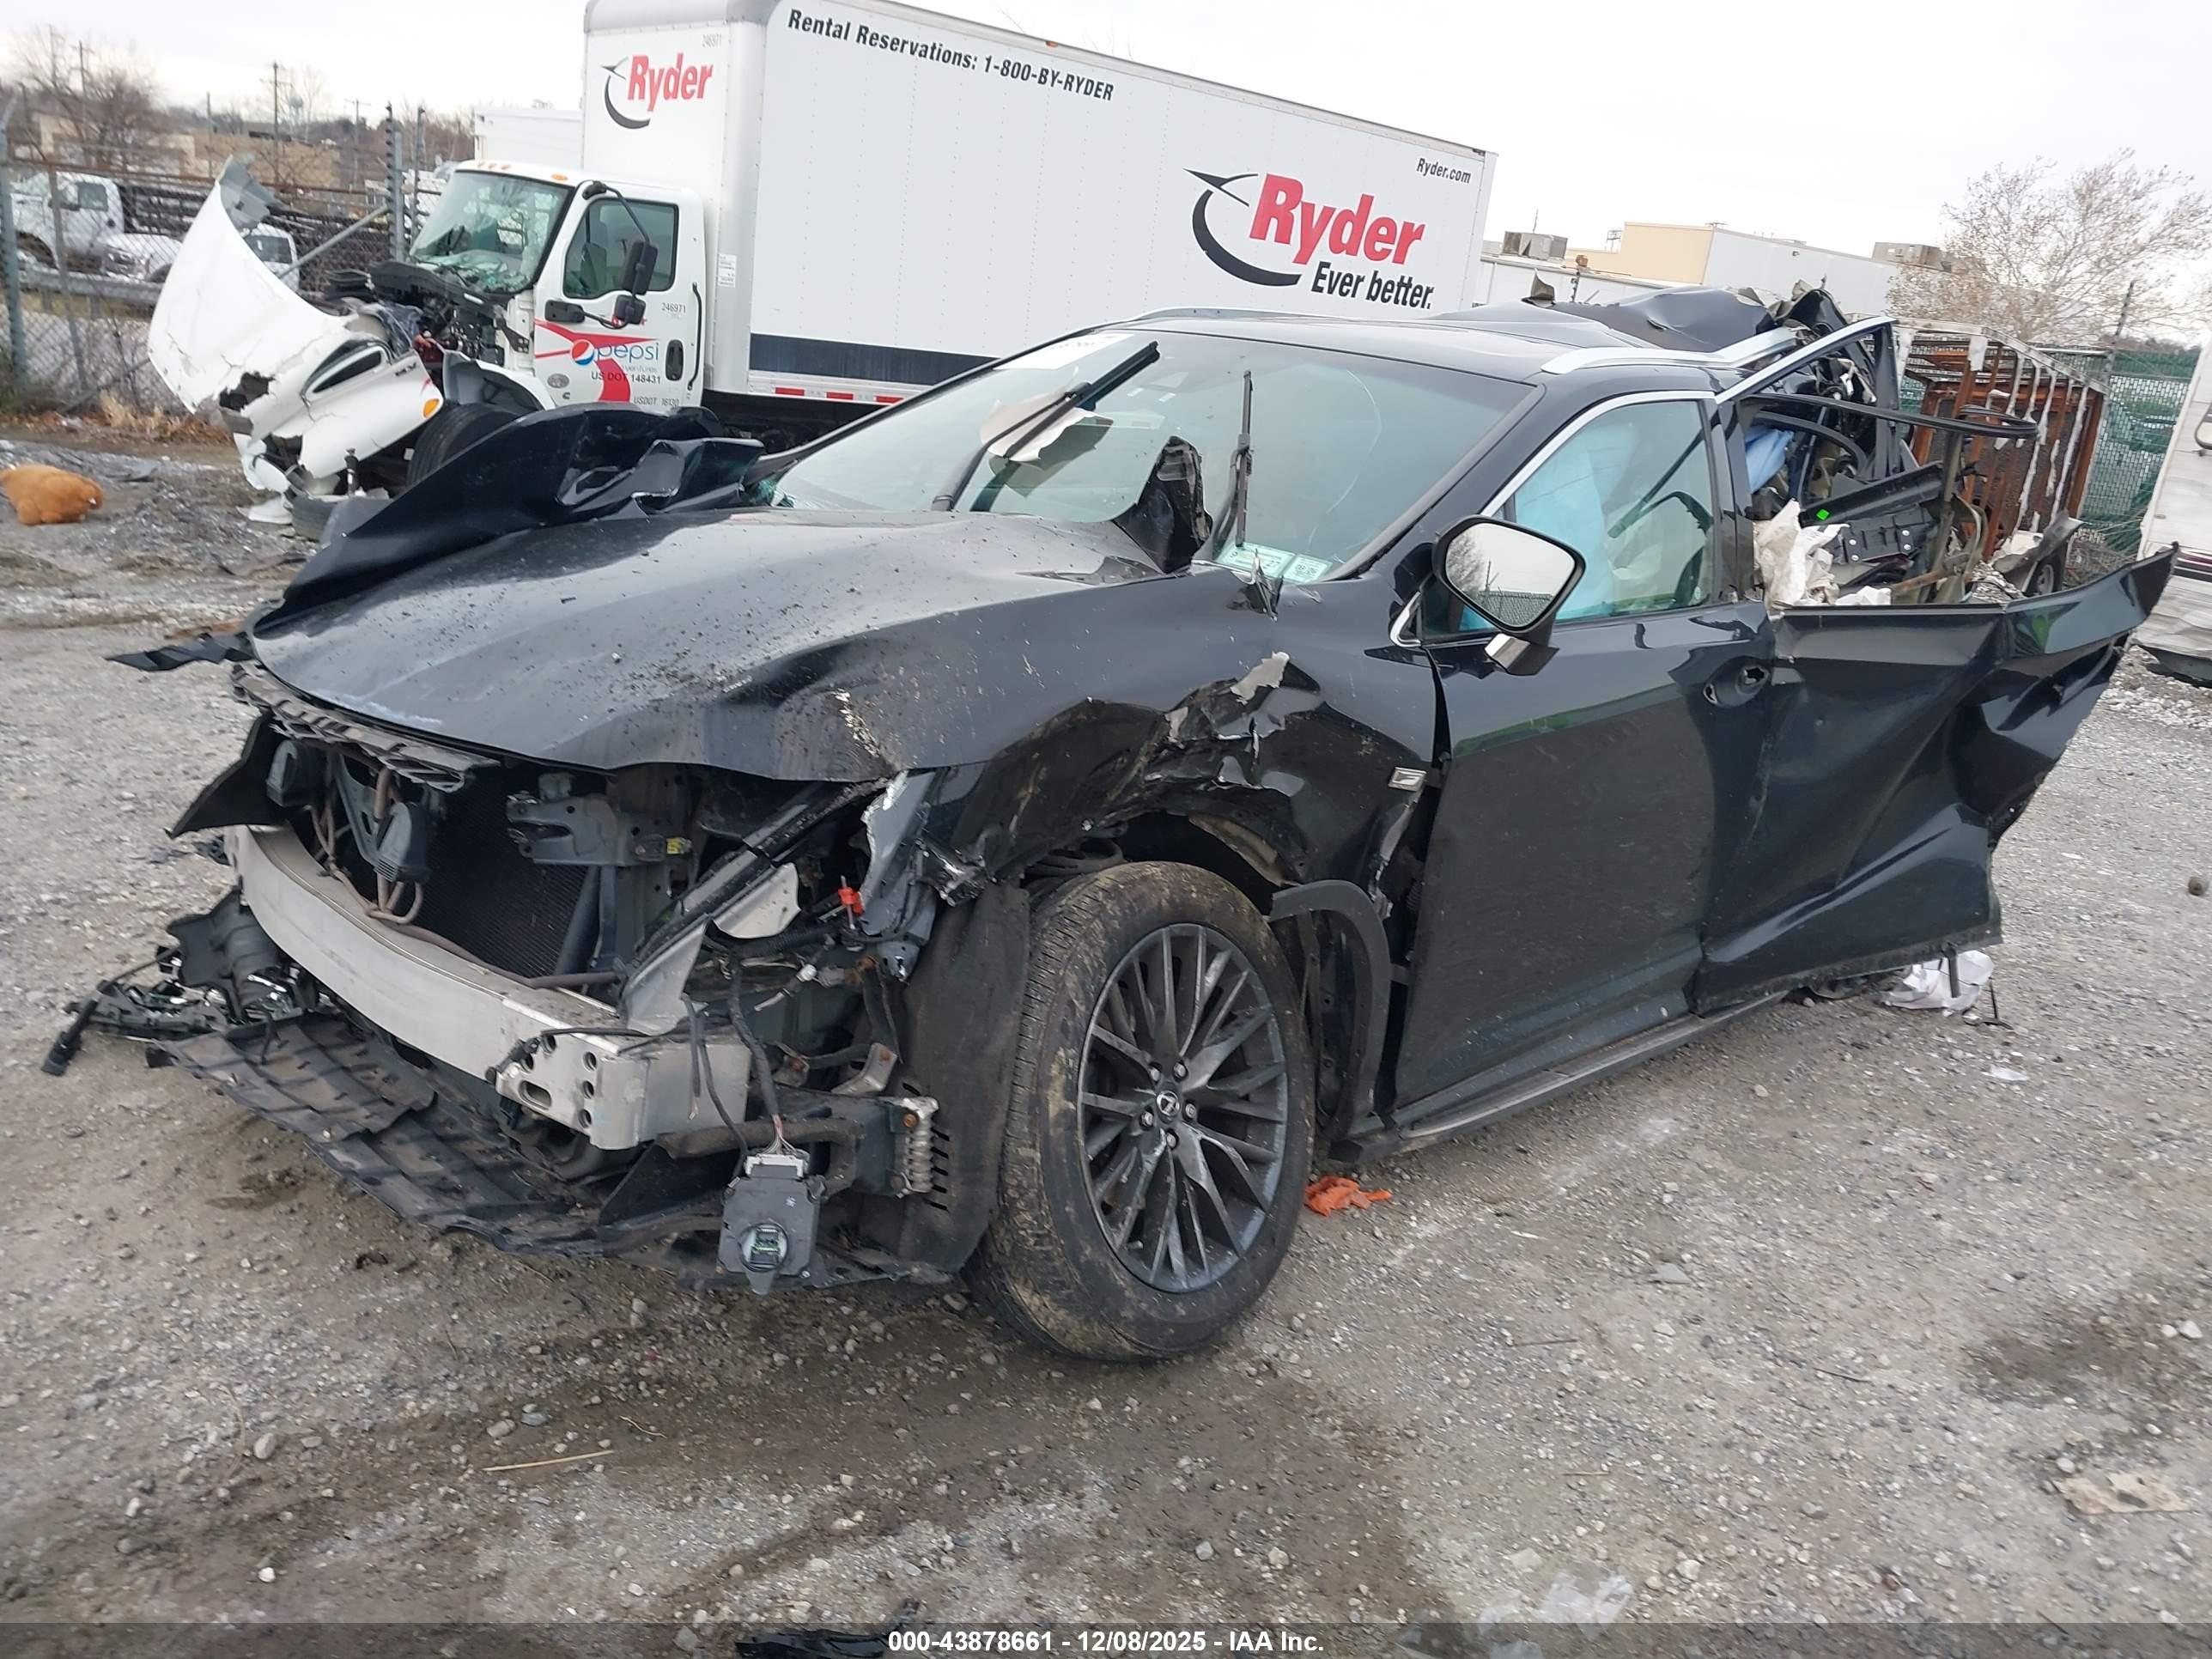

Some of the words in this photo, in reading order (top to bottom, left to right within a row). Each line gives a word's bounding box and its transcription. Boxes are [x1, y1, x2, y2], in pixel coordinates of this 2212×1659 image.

[787, 8, 852, 41] Rental
[855, 24, 978, 70] Reservations:
[984, 54, 1115, 101] 1-800-BY-RYDER
[627, 52, 714, 112] Ryder
[1416, 157, 1472, 185] Ryder.com
[1249, 173, 1426, 265] Ryder
[1310, 260, 1365, 299] Ever
[1364, 269, 1436, 310] better.
[660, 301, 687, 314] 246971
[597, 342, 659, 363] pepsi
[591, 371, 605, 380] US
[606, 371, 629, 382] DOT
[631, 373, 661, 386] 148431
